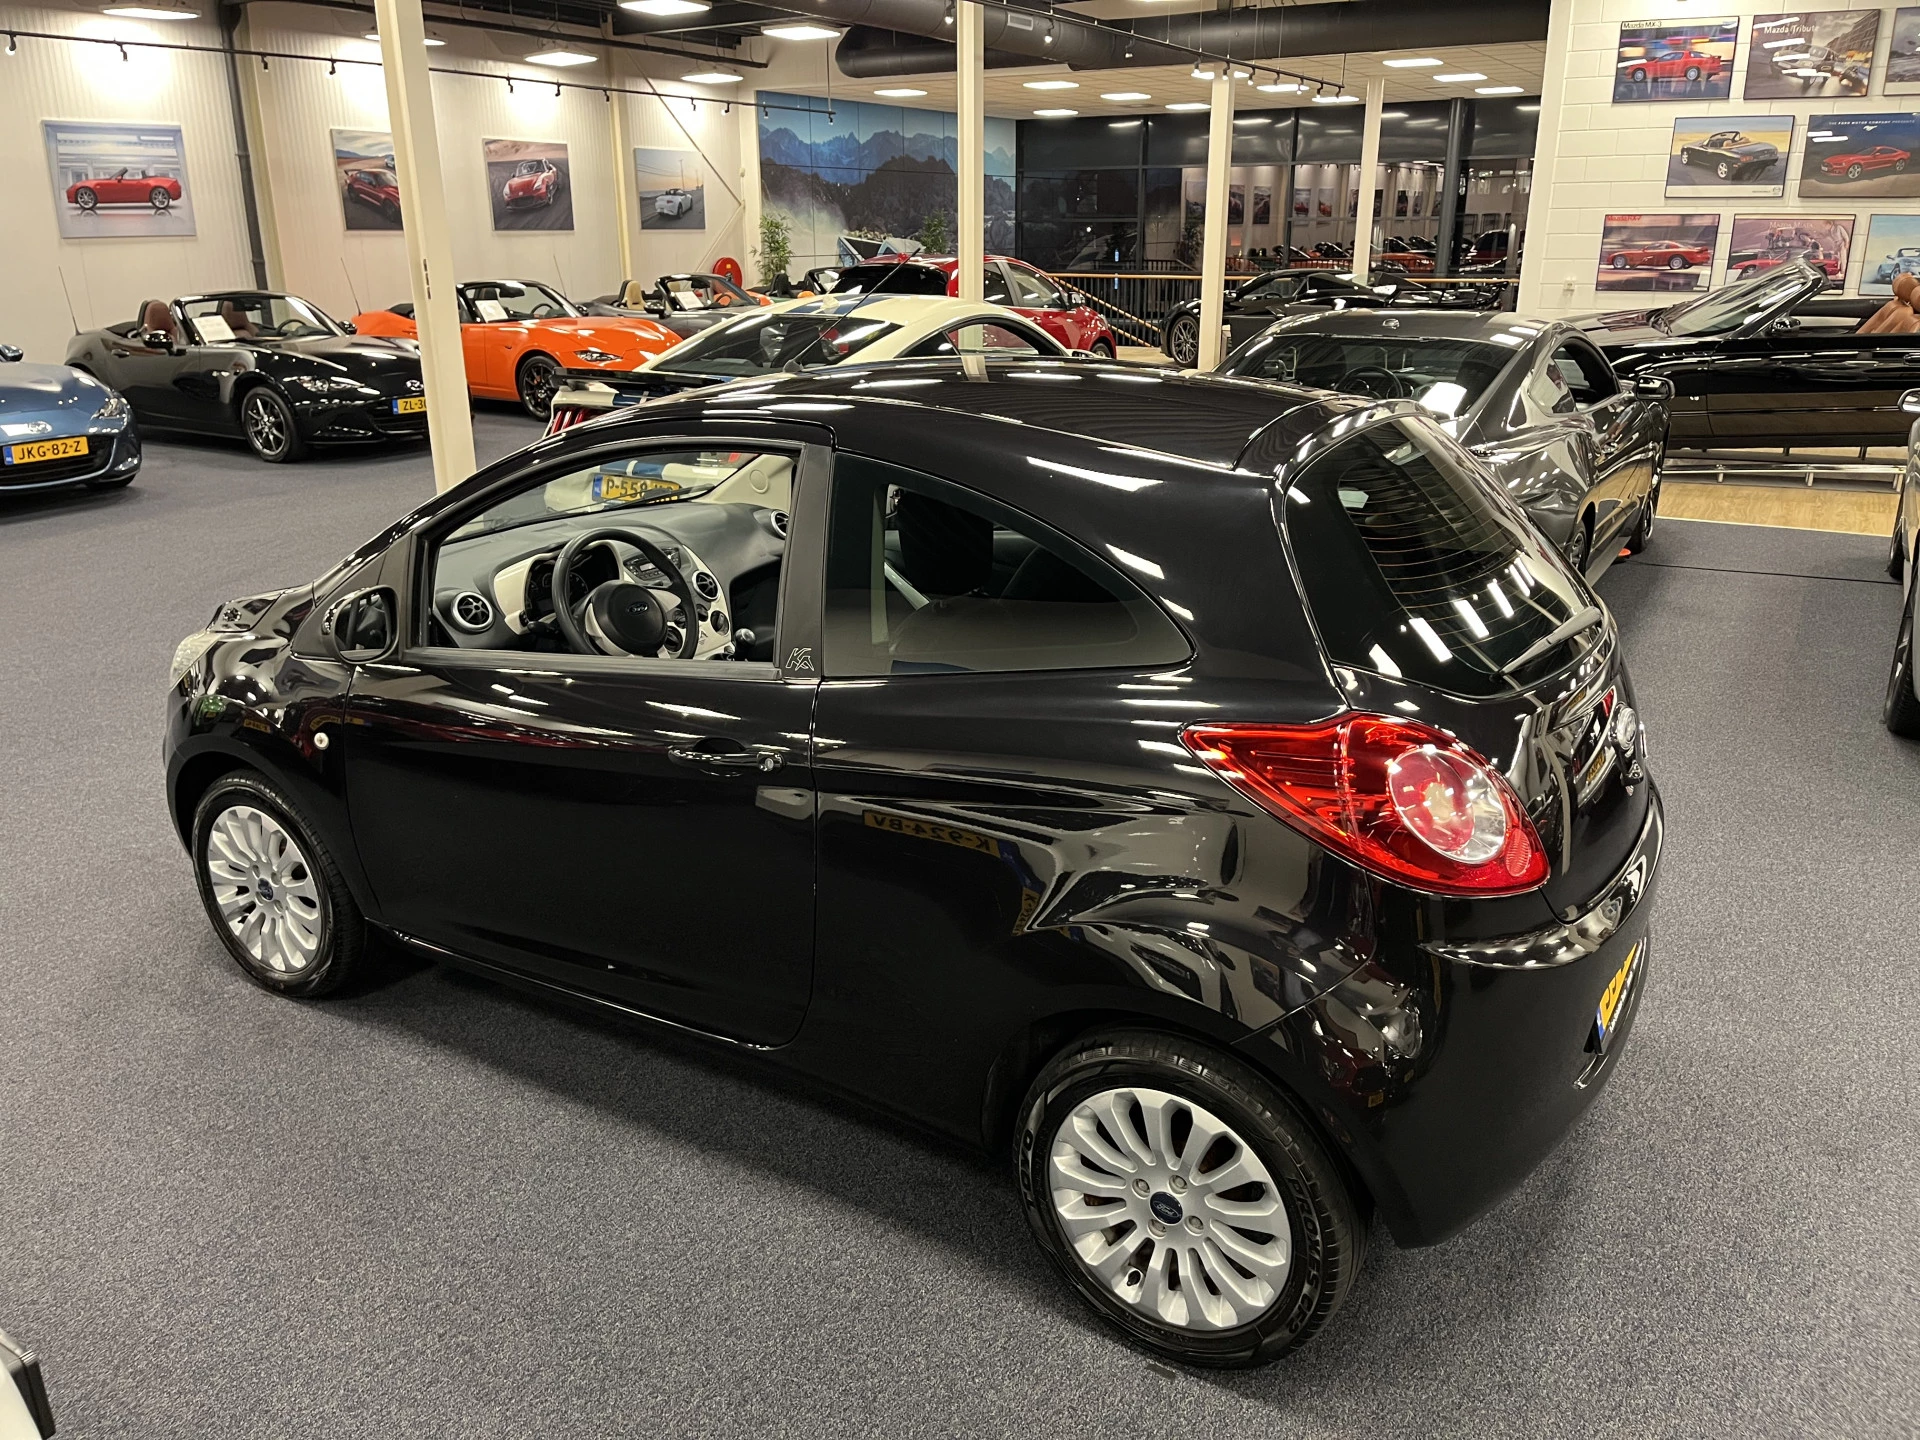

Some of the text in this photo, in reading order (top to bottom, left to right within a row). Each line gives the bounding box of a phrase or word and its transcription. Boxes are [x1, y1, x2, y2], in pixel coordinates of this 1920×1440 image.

[1764, 25, 1820, 34] Mazda Tribute
[19, 440, 82, 460] JKG-82-Z
[1286, 1176, 1322, 1290] PROXES
